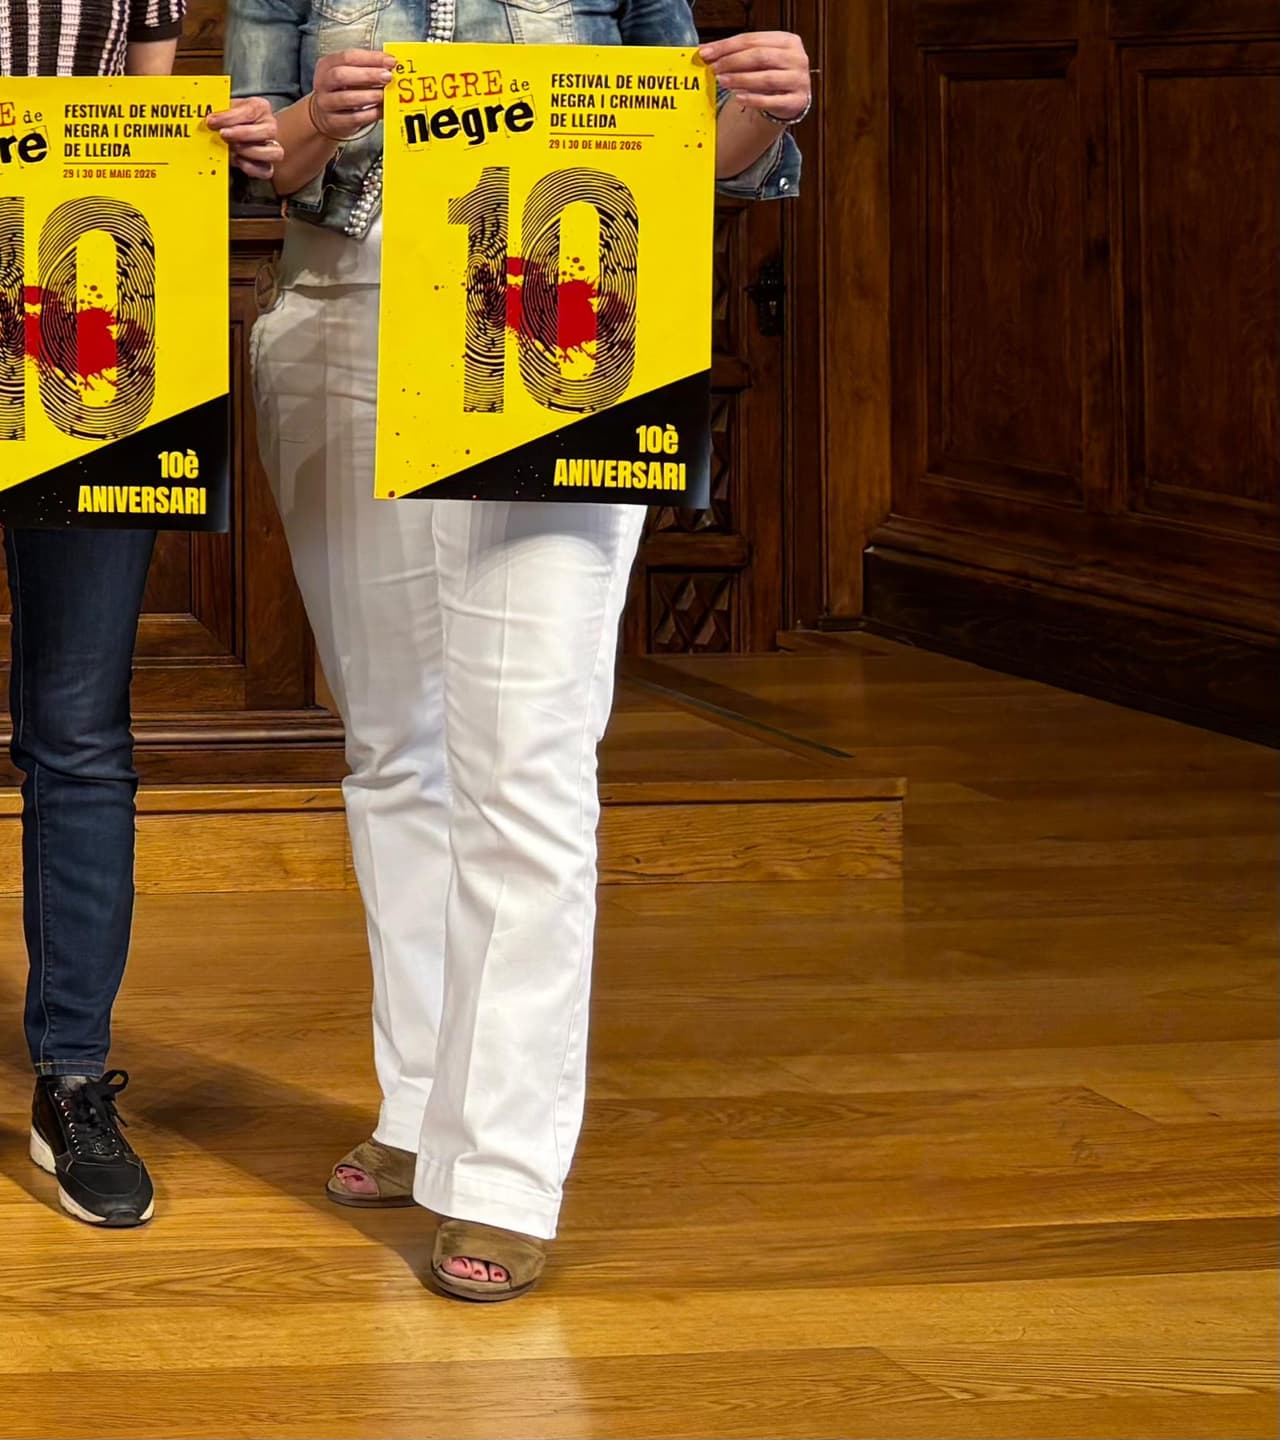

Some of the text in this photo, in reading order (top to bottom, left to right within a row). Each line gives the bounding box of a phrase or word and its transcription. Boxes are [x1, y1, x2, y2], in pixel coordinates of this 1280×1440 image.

[396, 60, 416, 74] el
[398, 70, 530, 104] SEGRE de
[551, 74, 610, 88] FESTIVAL
[616, 74, 632, 89] DE
[551, 94, 677, 110] NEGRA I CRIMINAL
[23, 110, 43, 124] de
[64, 104, 125, 118] FESTIVAL
[129, 104, 147, 118] DE
[405, 101, 534, 145] negre
[550, 114, 617, 128] DE LLEIDA
[64, 124, 190, 138] NEGRA I CRIMINAL
[64, 143, 131, 157] DE LLEIDA
[549, 140, 560, 149] 29
[568, 140, 579, 149] 30
[581, 140, 592, 149] DE
[595, 140, 617, 150] MAIG
[620, 141, 642, 150] 2026
[63, 170, 74, 178] 29
[82, 170, 94, 178] 30
[97, 170, 107, 178] DE
[110, 170, 132, 179] MAIG
[134, 170, 156, 179] 2026
[448, 167, 639, 414] 10
[636, 423, 678, 454] 10è
[158, 449, 199, 479] 10è
[553, 458, 687, 491] ANIVERSARI
[78, 485, 207, 515] ANIVERSARI
